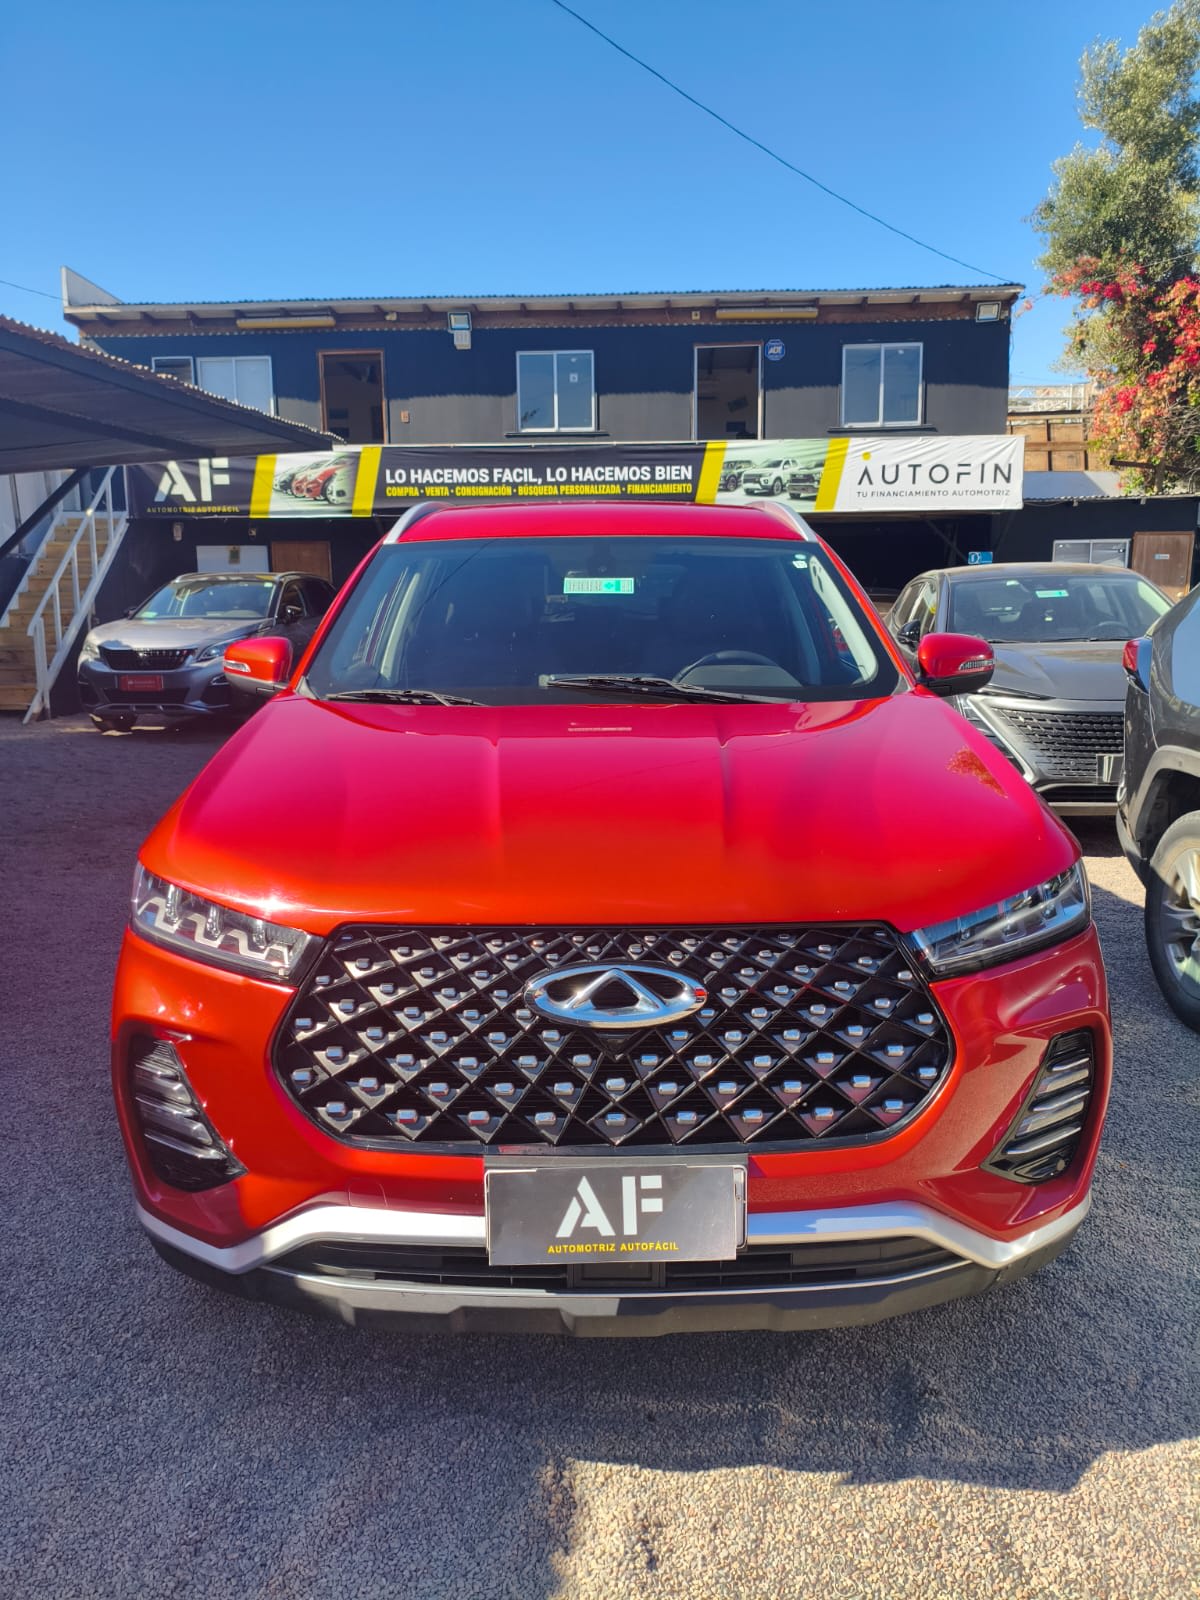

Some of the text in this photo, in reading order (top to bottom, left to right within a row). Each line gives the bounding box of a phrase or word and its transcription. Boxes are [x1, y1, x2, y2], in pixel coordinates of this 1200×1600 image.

[154, 457, 230, 502] AF
[385, 465, 692, 485] LO HACEMOS FACIL, LO HACEMOS BIEN
[857, 463, 1012, 486] AUTOFIN
[385, 483, 692, 497] COMPRA VENTA CONSIGNACIÓN BÚSQUEDA PERSONALIZADA FINANCIAMIENTO
[871, 489, 949, 497] FINANCIAMIENTO
[555, 1175, 663, 1238] AF
[547, 1240, 679, 1254] AUTOMOTRIZ AUTOFÁCIL
